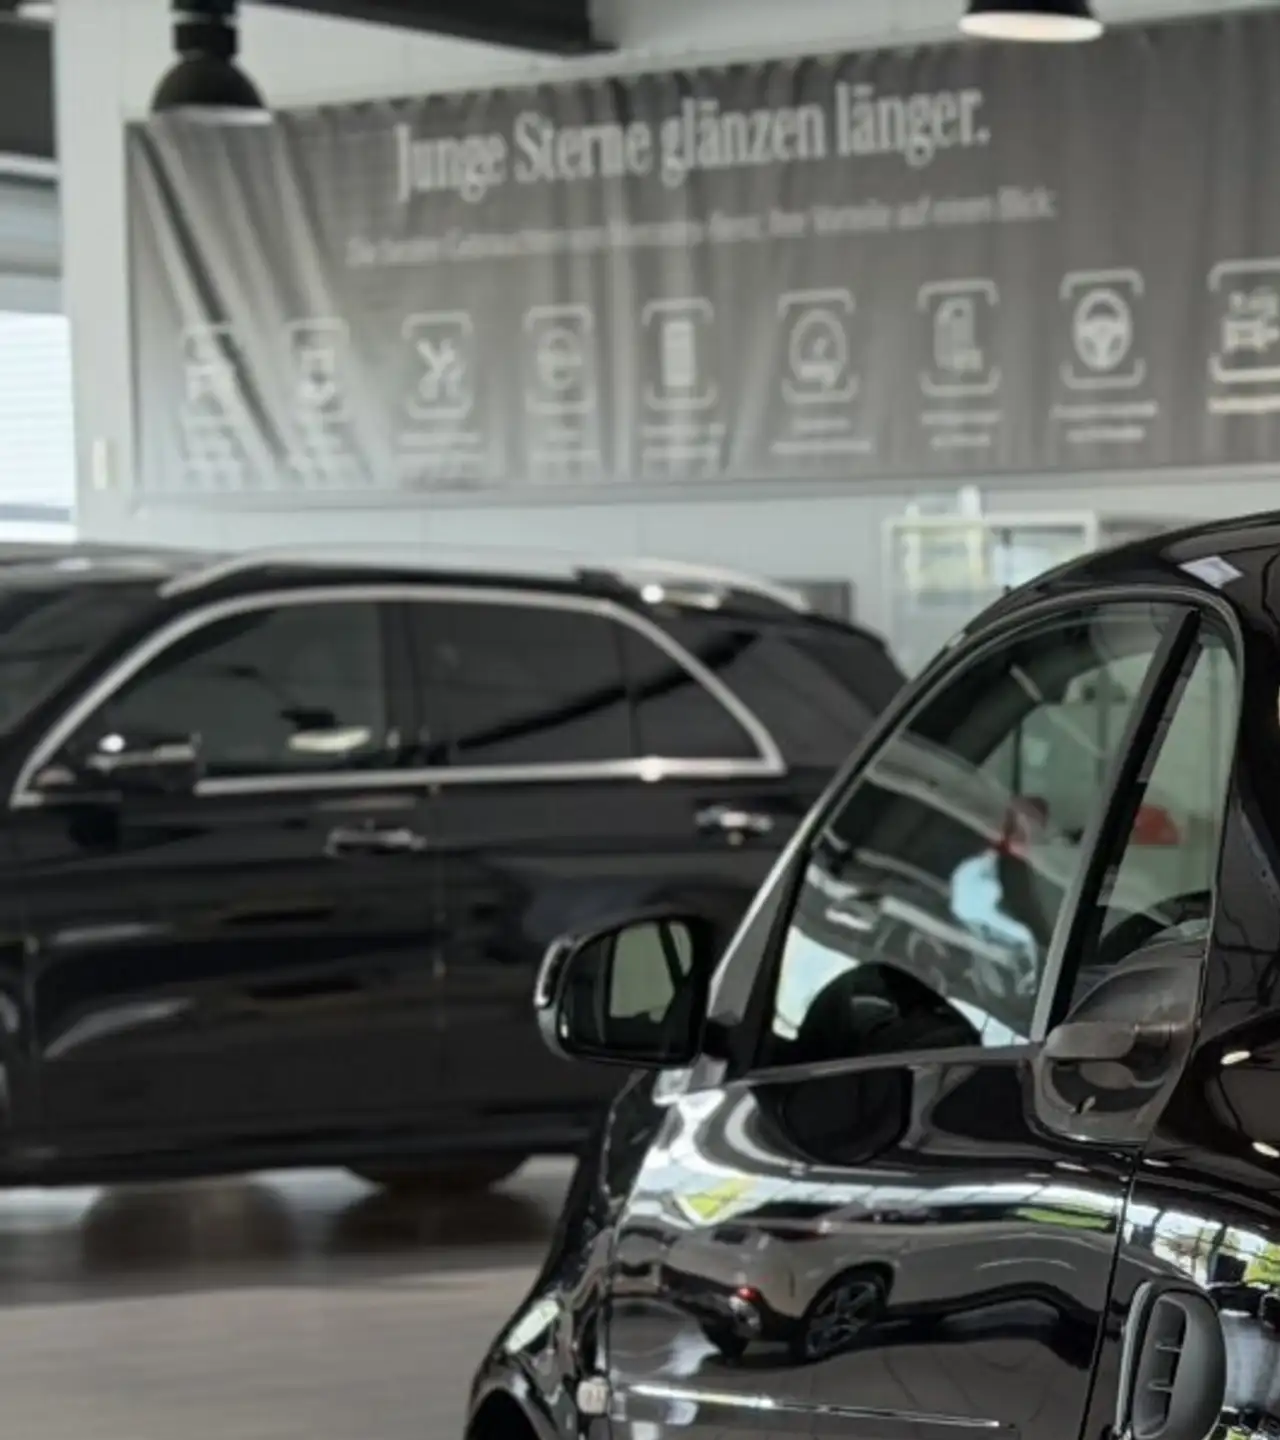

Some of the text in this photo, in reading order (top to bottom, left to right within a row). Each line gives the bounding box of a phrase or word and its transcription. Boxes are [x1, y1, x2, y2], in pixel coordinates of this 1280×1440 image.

[394, 81, 991, 203] Junge Sterne glänzen länger.
